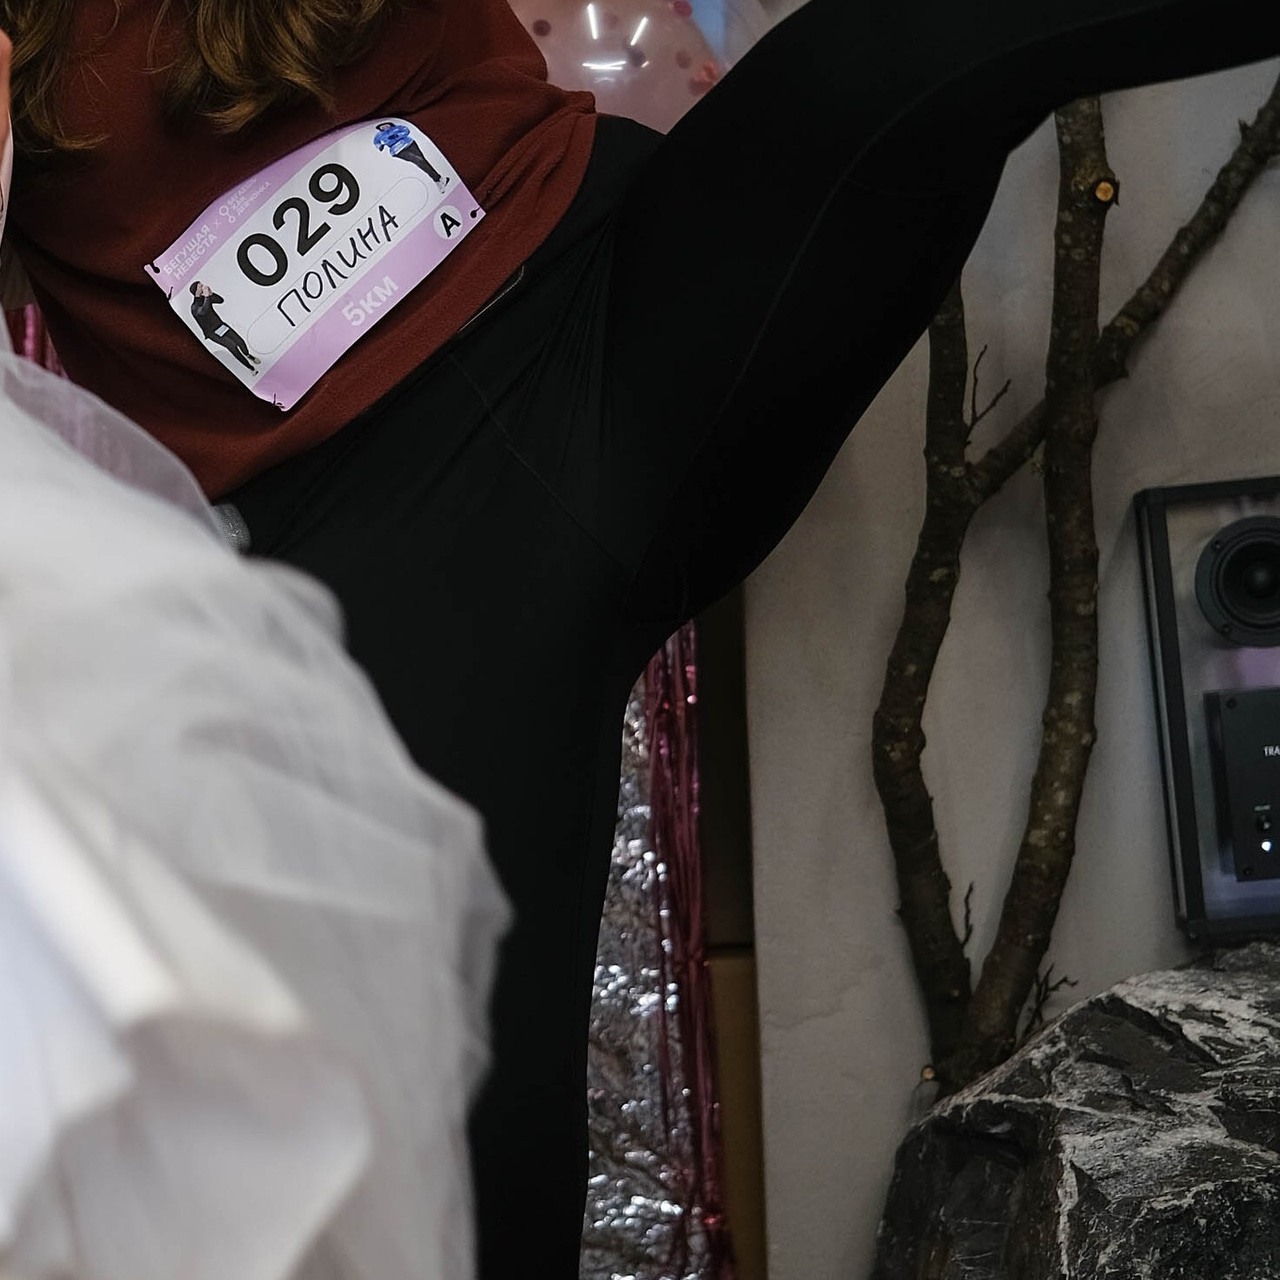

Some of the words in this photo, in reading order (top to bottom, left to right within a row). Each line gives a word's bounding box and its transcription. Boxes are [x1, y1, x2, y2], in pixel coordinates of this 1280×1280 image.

[163, 224, 211, 275] БЕГУЩАЯ
[173, 233, 218, 280] НЕВЕСТА
[236, 163, 361, 287] 029
[277, 205, 399, 327] ПОЛИНА
